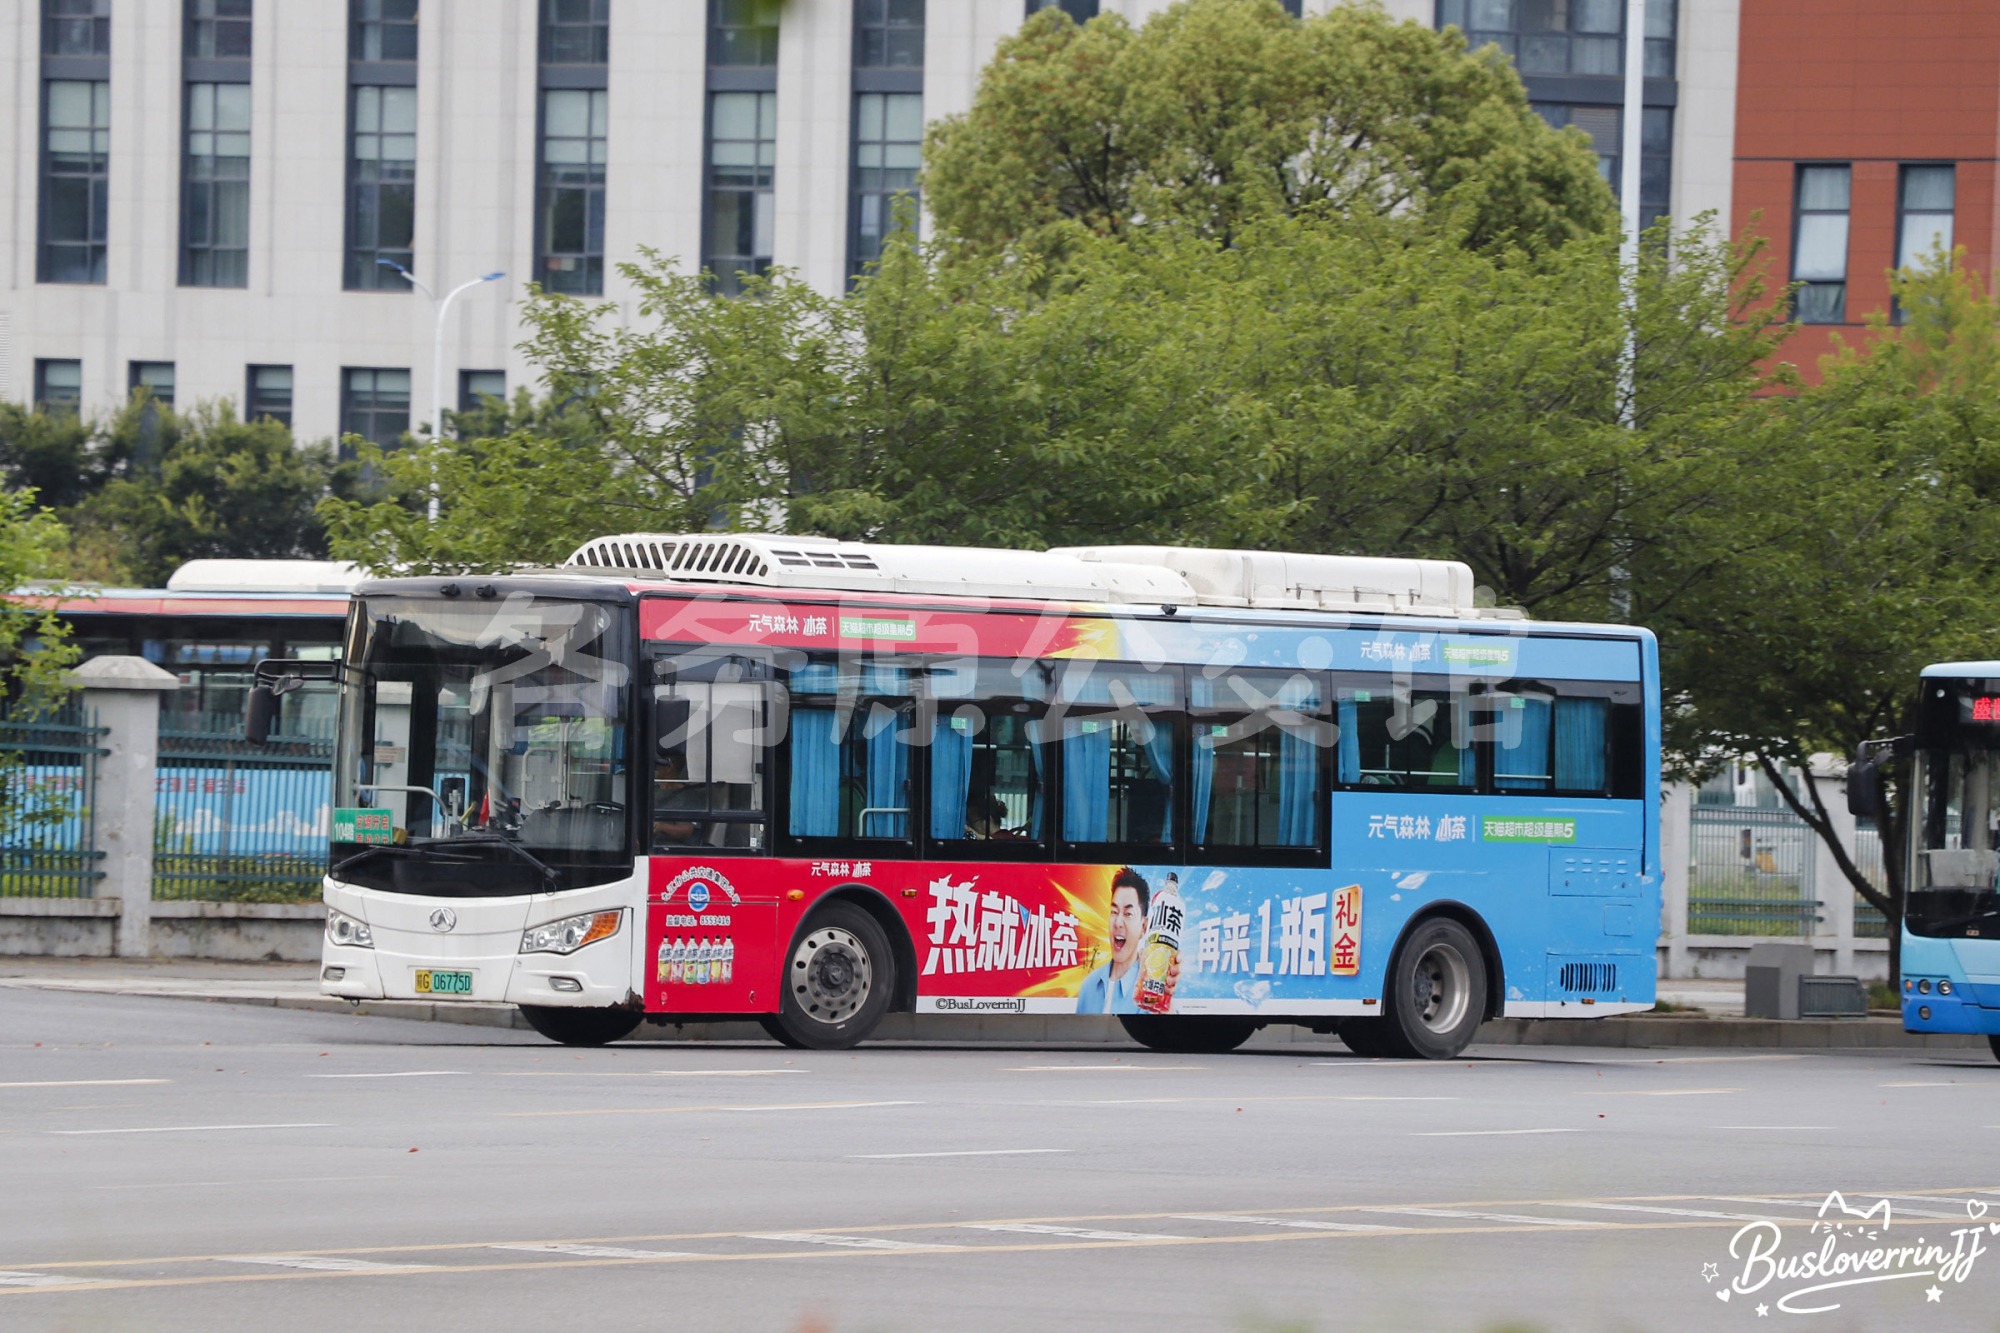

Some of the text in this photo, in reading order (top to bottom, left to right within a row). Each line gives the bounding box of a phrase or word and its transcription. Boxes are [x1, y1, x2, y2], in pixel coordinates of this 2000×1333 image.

[749, 614, 799, 634] 元气森林
[802, 615, 827, 636] 冰茶
[1360, 641, 1405, 660] 元气森林
[1408, 642, 1431, 662] 冰茶
[1368, 814, 1574, 842] 元气森林 冰茶 天猫超市超级星期5
[811, 861, 872, 878] 元气森林 冰茶
[921, 873, 1079, 976] 热就冰茶
[1199, 893, 1327, 976] 再来1瓶
[1334, 892, 1358, 969] 礼金
